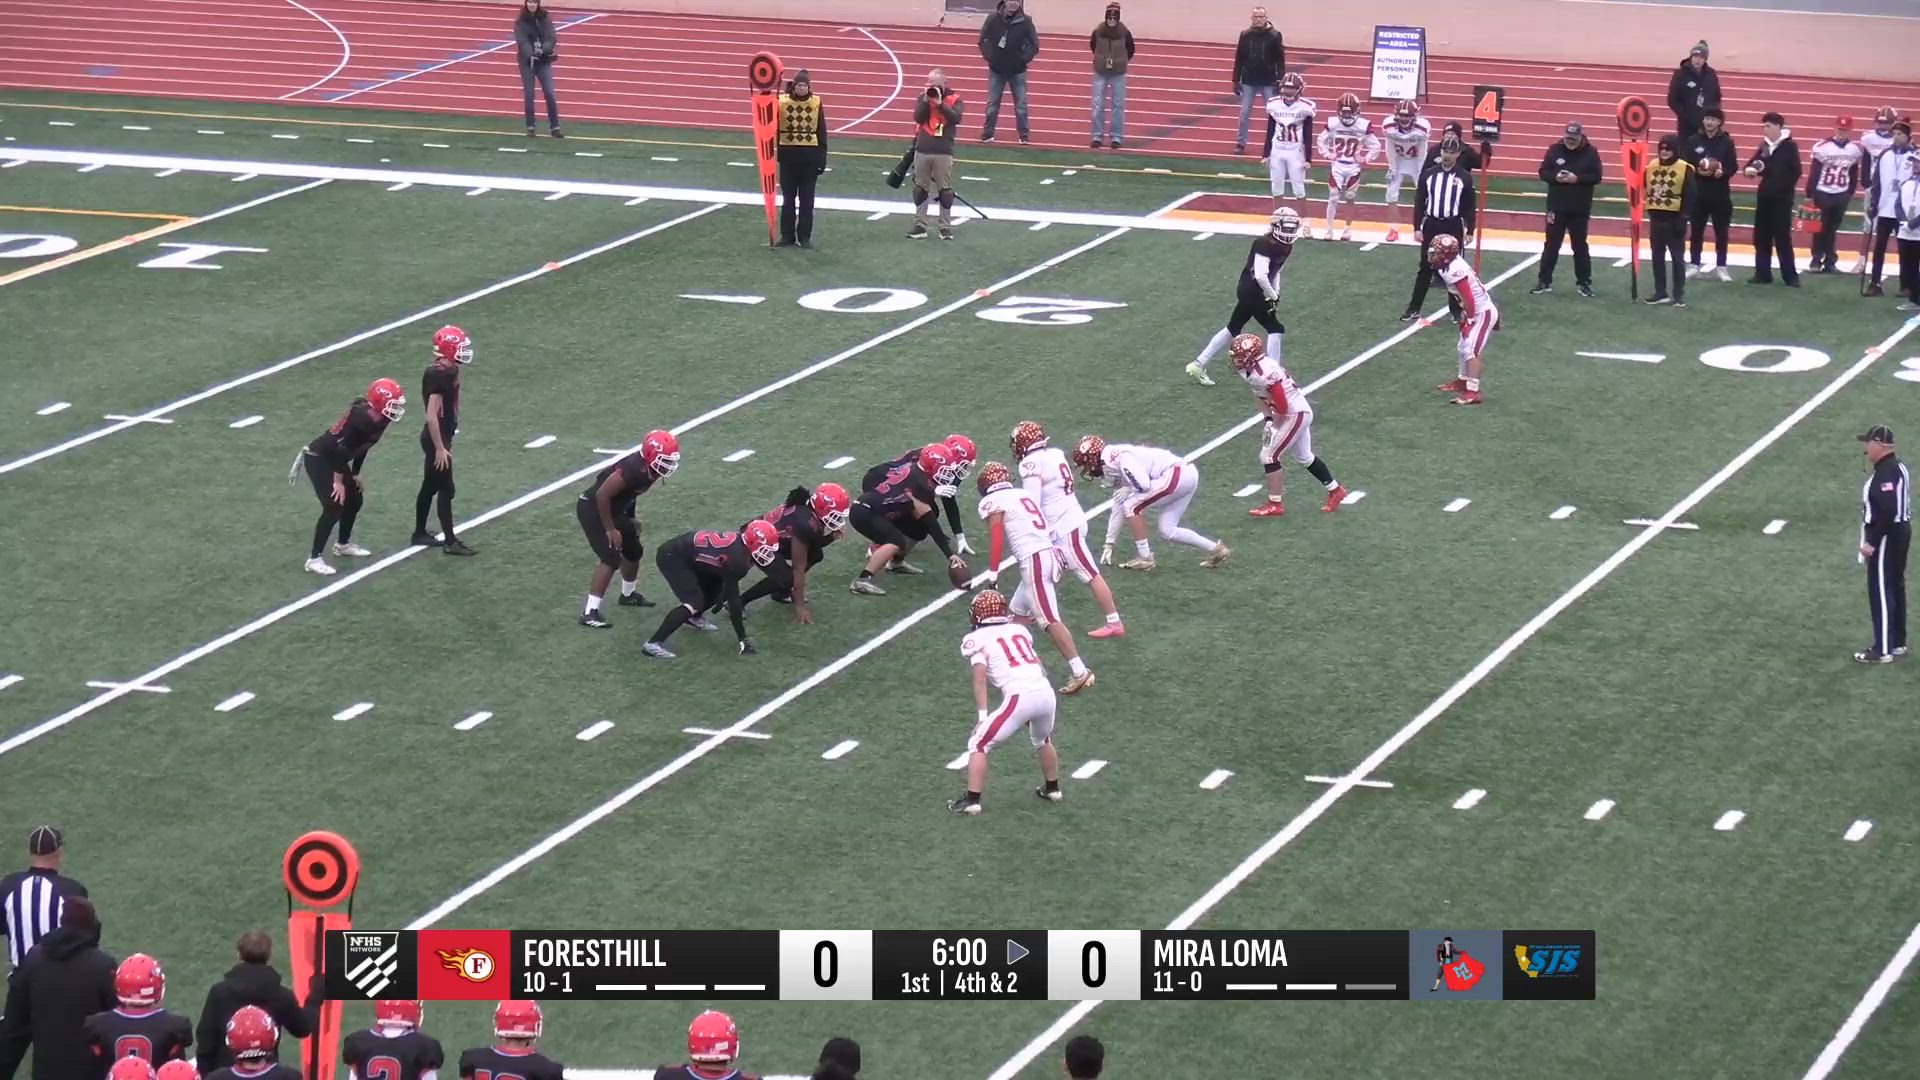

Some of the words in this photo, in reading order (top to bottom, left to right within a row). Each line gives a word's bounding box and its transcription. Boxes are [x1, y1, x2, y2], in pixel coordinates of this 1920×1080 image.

[1378, 31, 1420, 39] RESTRICTED
[1377, 65, 1416, 73] PERSONNEL
[1474, 91, 1500, 123] 4
[1334, 137, 1360, 158] 20
[1823, 166, 1848, 187] 66
[1058, 463, 1075, 496] 8
[1019, 497, 1047, 530] 9
[996, 633, 1040, 668] 10
